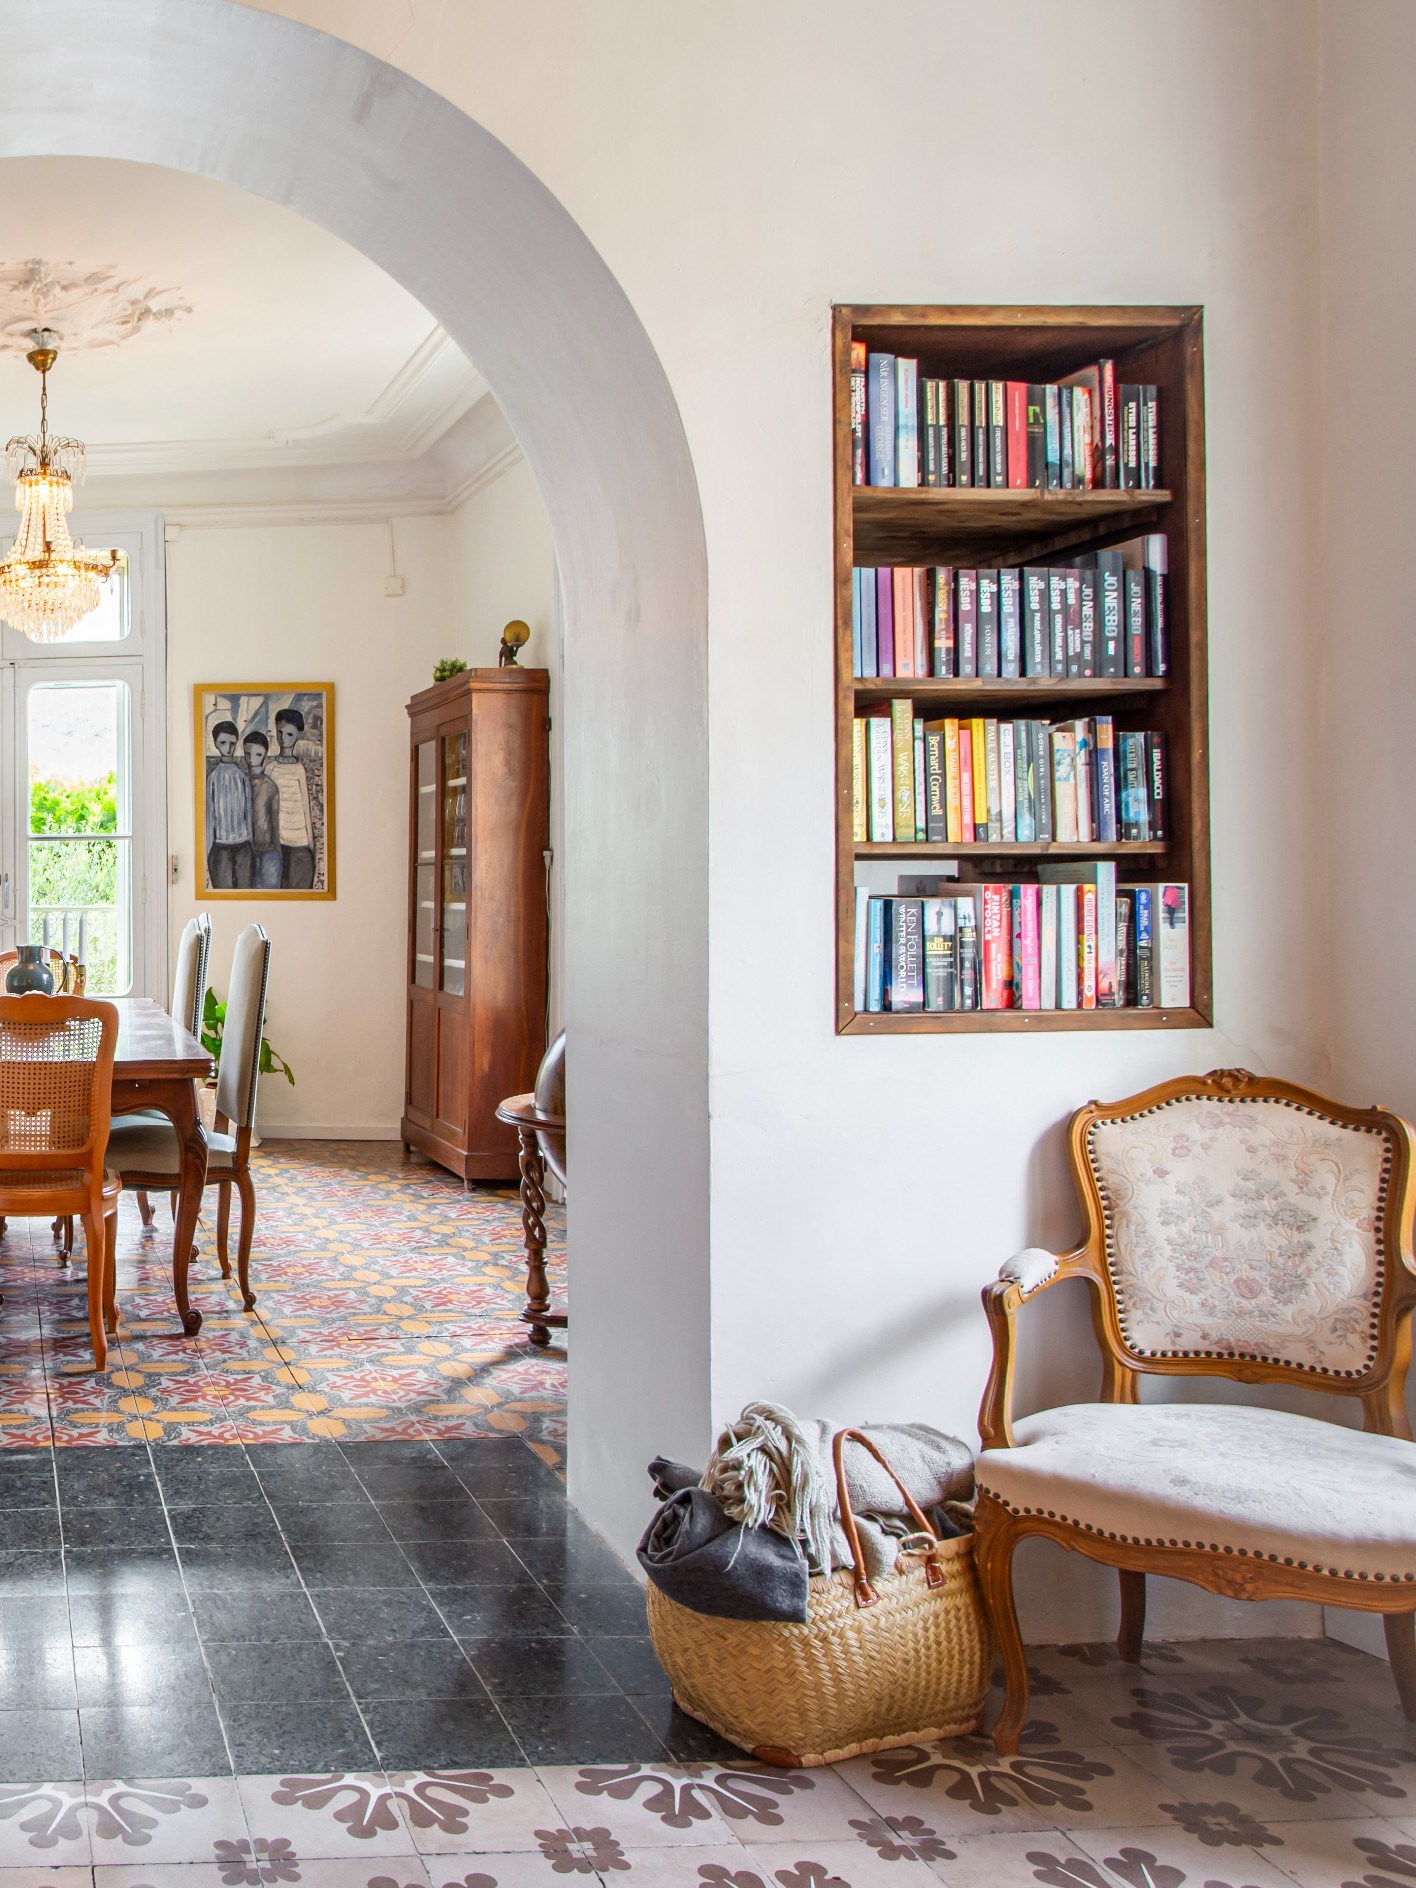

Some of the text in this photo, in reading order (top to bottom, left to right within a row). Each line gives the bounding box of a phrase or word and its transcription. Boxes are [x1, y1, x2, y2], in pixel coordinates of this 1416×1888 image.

[878, 360, 889, 422] NÄR INGEN SER
[875, 426, 884, 460] GEORGE
[1128, 402, 1136, 467] STIEG LARSSON
[1148, 402, 1156, 466] STIEG LARSSON
[970, 580, 976, 590] JO
[990, 582, 997, 592] JO
[1012, 580, 1019, 590] JO
[1038, 580, 1045, 590] JO
[1058, 580, 1066, 590] JO
[1074, 580, 1080, 588] JO
[1082, 584, 1093, 600] JO
[1104, 572, 1118, 590] JO
[1130, 582, 1141, 597] JO
[1104, 592, 1118, 637] NESBØ
[1131, 598, 1142, 634] NESBØ
[897, 752, 910, 778] WARS
[928, 736, 942, 774] Bernard
[987, 726, 996, 788] PAUL AUSTER
[1101, 761, 1109, 782] JOAN
[1102, 784, 1110, 796] OF
[1128, 771, 1136, 790] SMIT
[1153, 752, 1162, 799] BALDACCI
[930, 776, 943, 816] Cornwell
[898, 904, 906, 944] WINTER
[992, 895, 1000, 937] FINTAN
[1086, 897, 1094, 943] HOMEGOING
[907, 908, 917, 987] KEN FOLLETT
[926, 942, 952, 950] FOLLETT
[898, 954, 906, 992] WORLD
